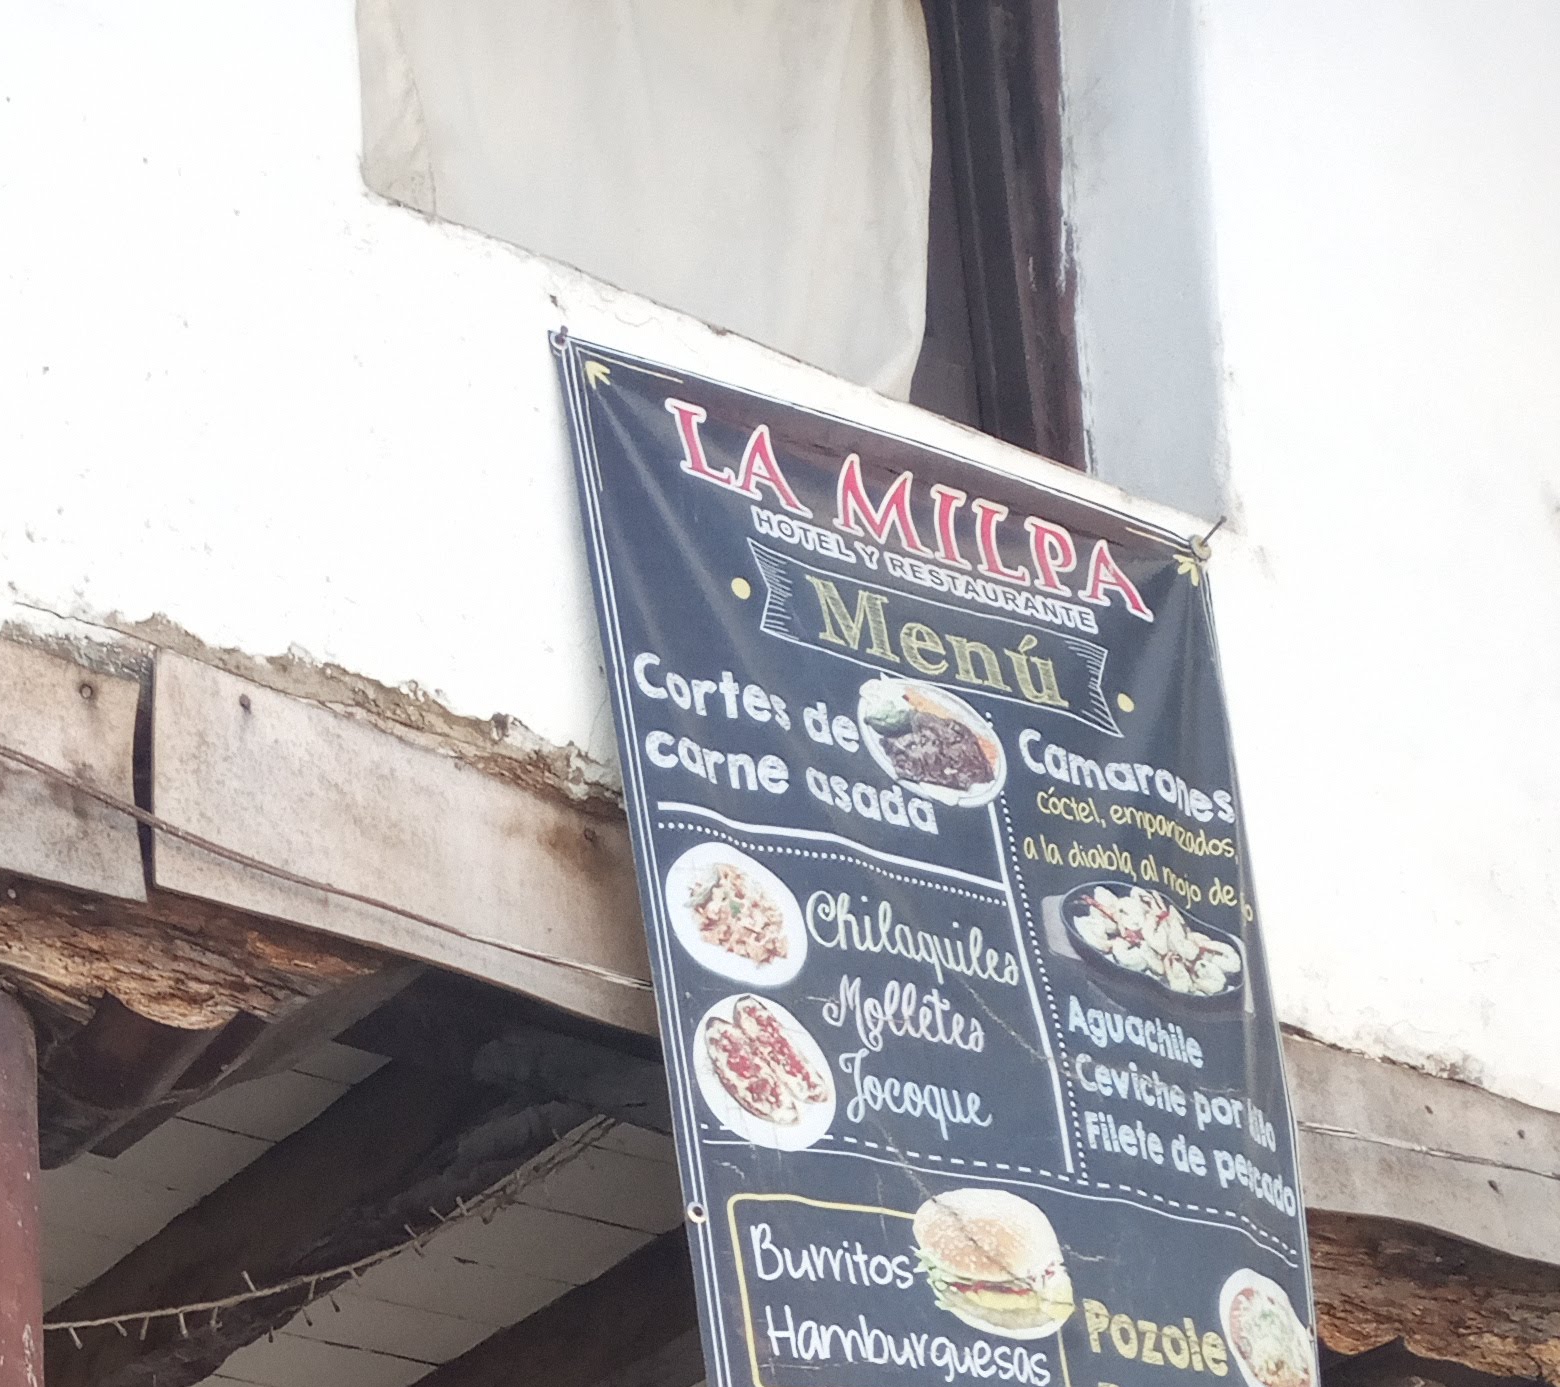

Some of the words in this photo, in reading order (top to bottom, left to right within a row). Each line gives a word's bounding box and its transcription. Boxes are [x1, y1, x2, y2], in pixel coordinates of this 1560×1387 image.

[665, 397, 812, 519] LA
[833, 453, 1154, 623] MILPA
[750, 504, 856, 564] HOTEL
[854, 540, 880, 571] Y
[885, 550, 1099, 635] RESTAURANTE
[805, 574, 1070, 708] Menú
[633, 651, 791, 731] Cortes
[803, 701, 860, 753] de
[645, 730, 789, 795] carne
[805, 766, 939, 836] asada
[1018, 728, 1236, 824] Camarones
[1036, 786, 1107, 828] cóctel,
[1023, 836, 1039, 860] a
[1041, 834, 1064, 866] la
[1068, 841, 1137, 883] diabla,
[1140, 854, 1160, 883] al
[1208, 876, 1239, 907] de
[806, 890, 1019, 985] Chilaquiles
[822, 974, 985, 1052] Molletes
[1068, 995, 1204, 1069] Aguachile
[839, 1047, 993, 1141] Jocoque
[1075, 1052, 1187, 1117] Ceviche
[1192, 1089, 1244, 1131] por
[1083, 1110, 1165, 1166] Filete
[1170, 1133, 1208, 1177] de
[1213, 1148, 1297, 1218] pescado
[749, 1222, 914, 1289] Burritos
[764, 1304, 1051, 1387] Hamburguesas
[1083, 1297, 1229, 1378] Pozole
